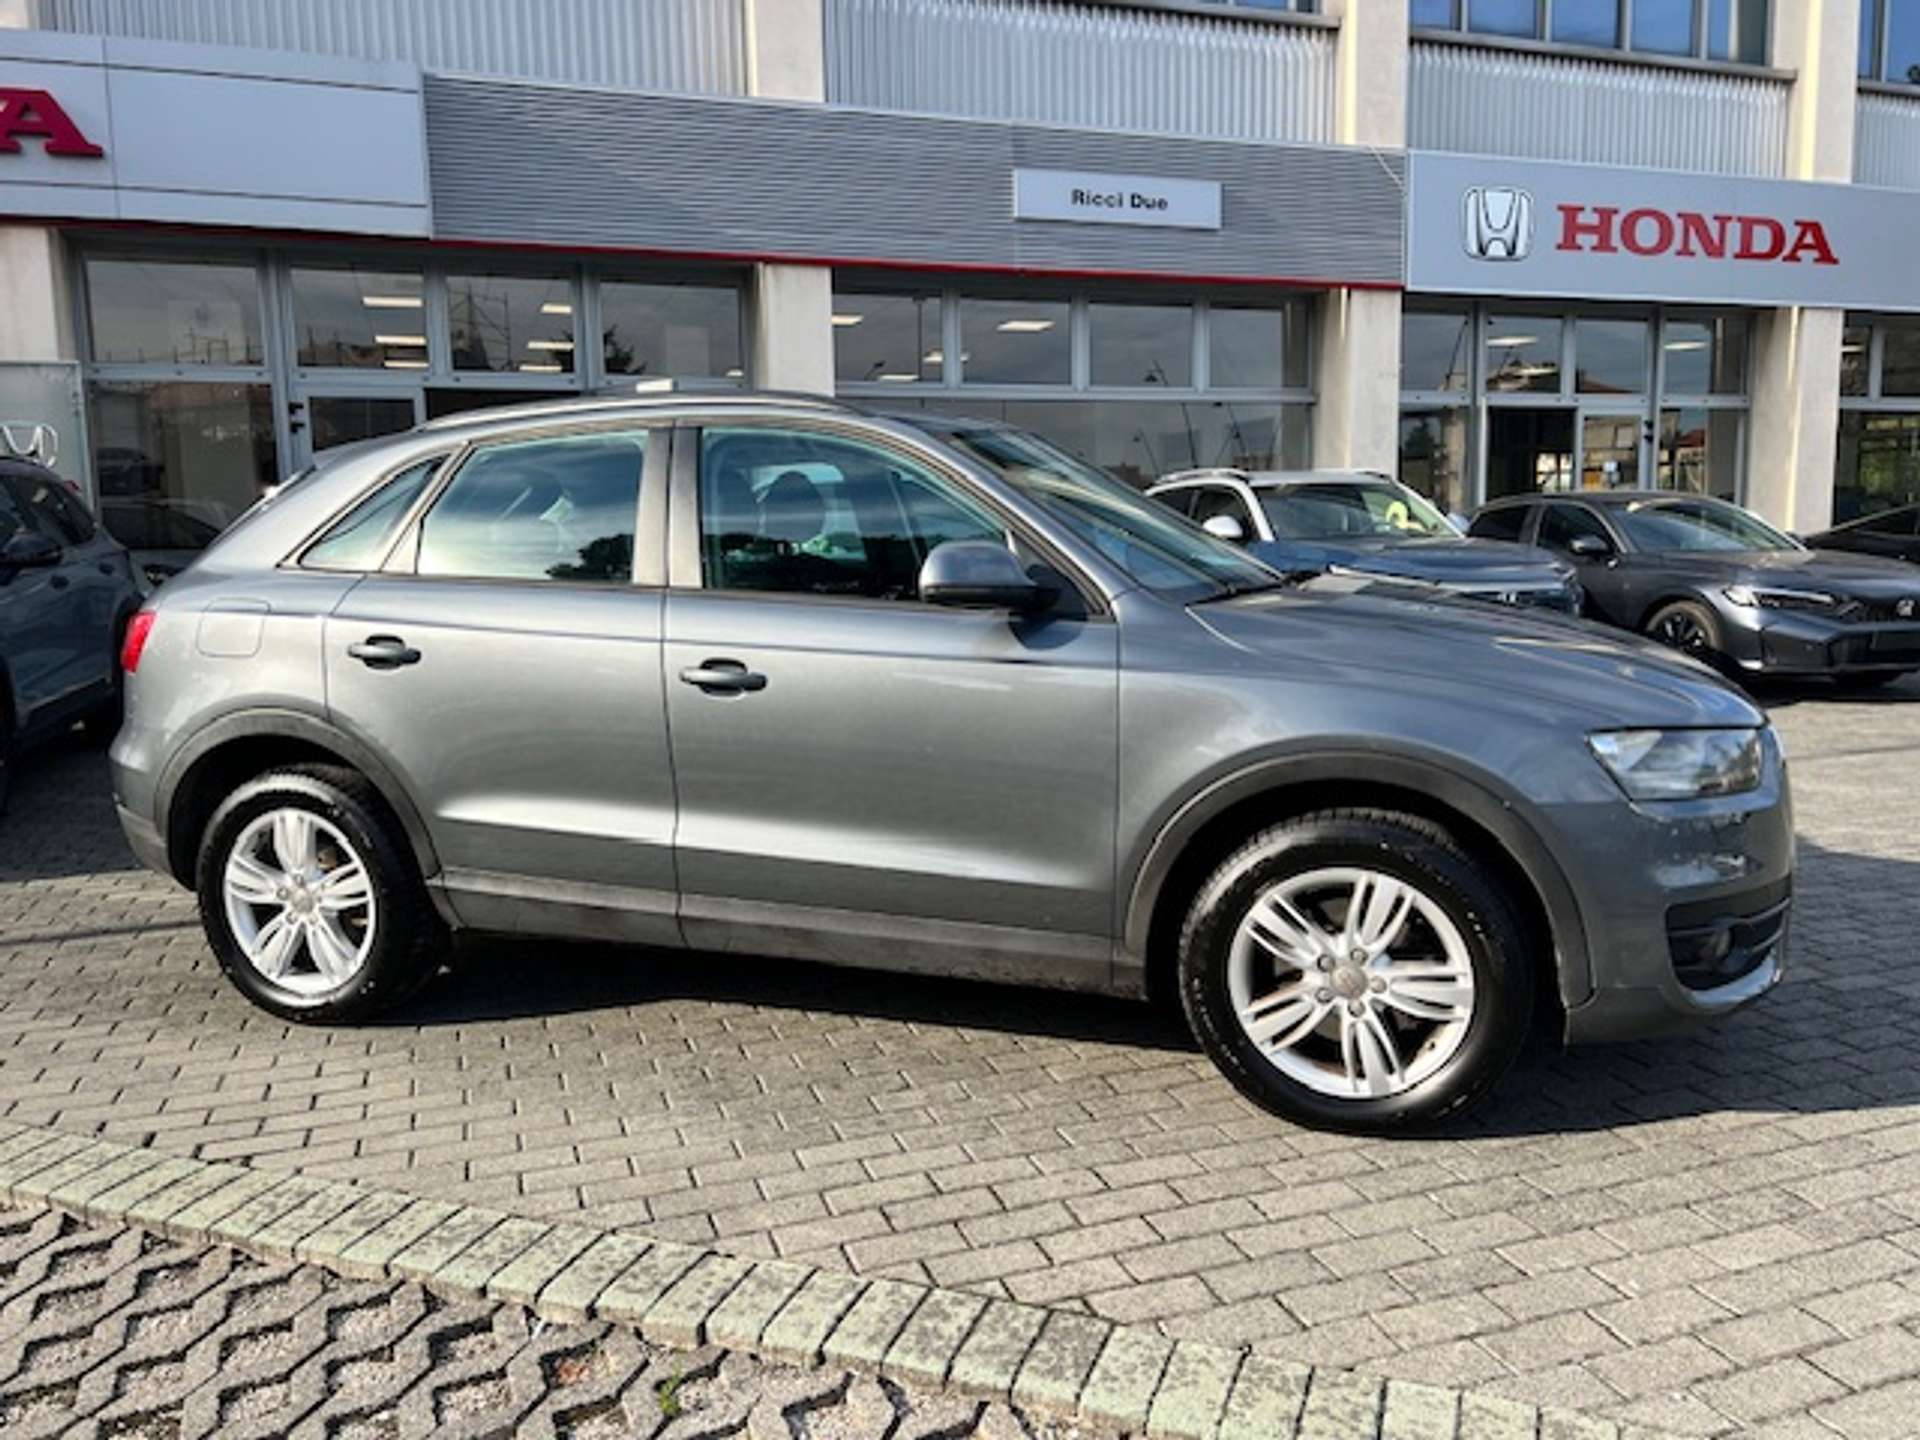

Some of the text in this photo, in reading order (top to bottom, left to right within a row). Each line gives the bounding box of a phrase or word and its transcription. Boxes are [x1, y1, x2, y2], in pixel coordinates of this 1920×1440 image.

[1071, 188, 1169, 210] Ricci Due
[1556, 204, 1840, 265] HONDA
